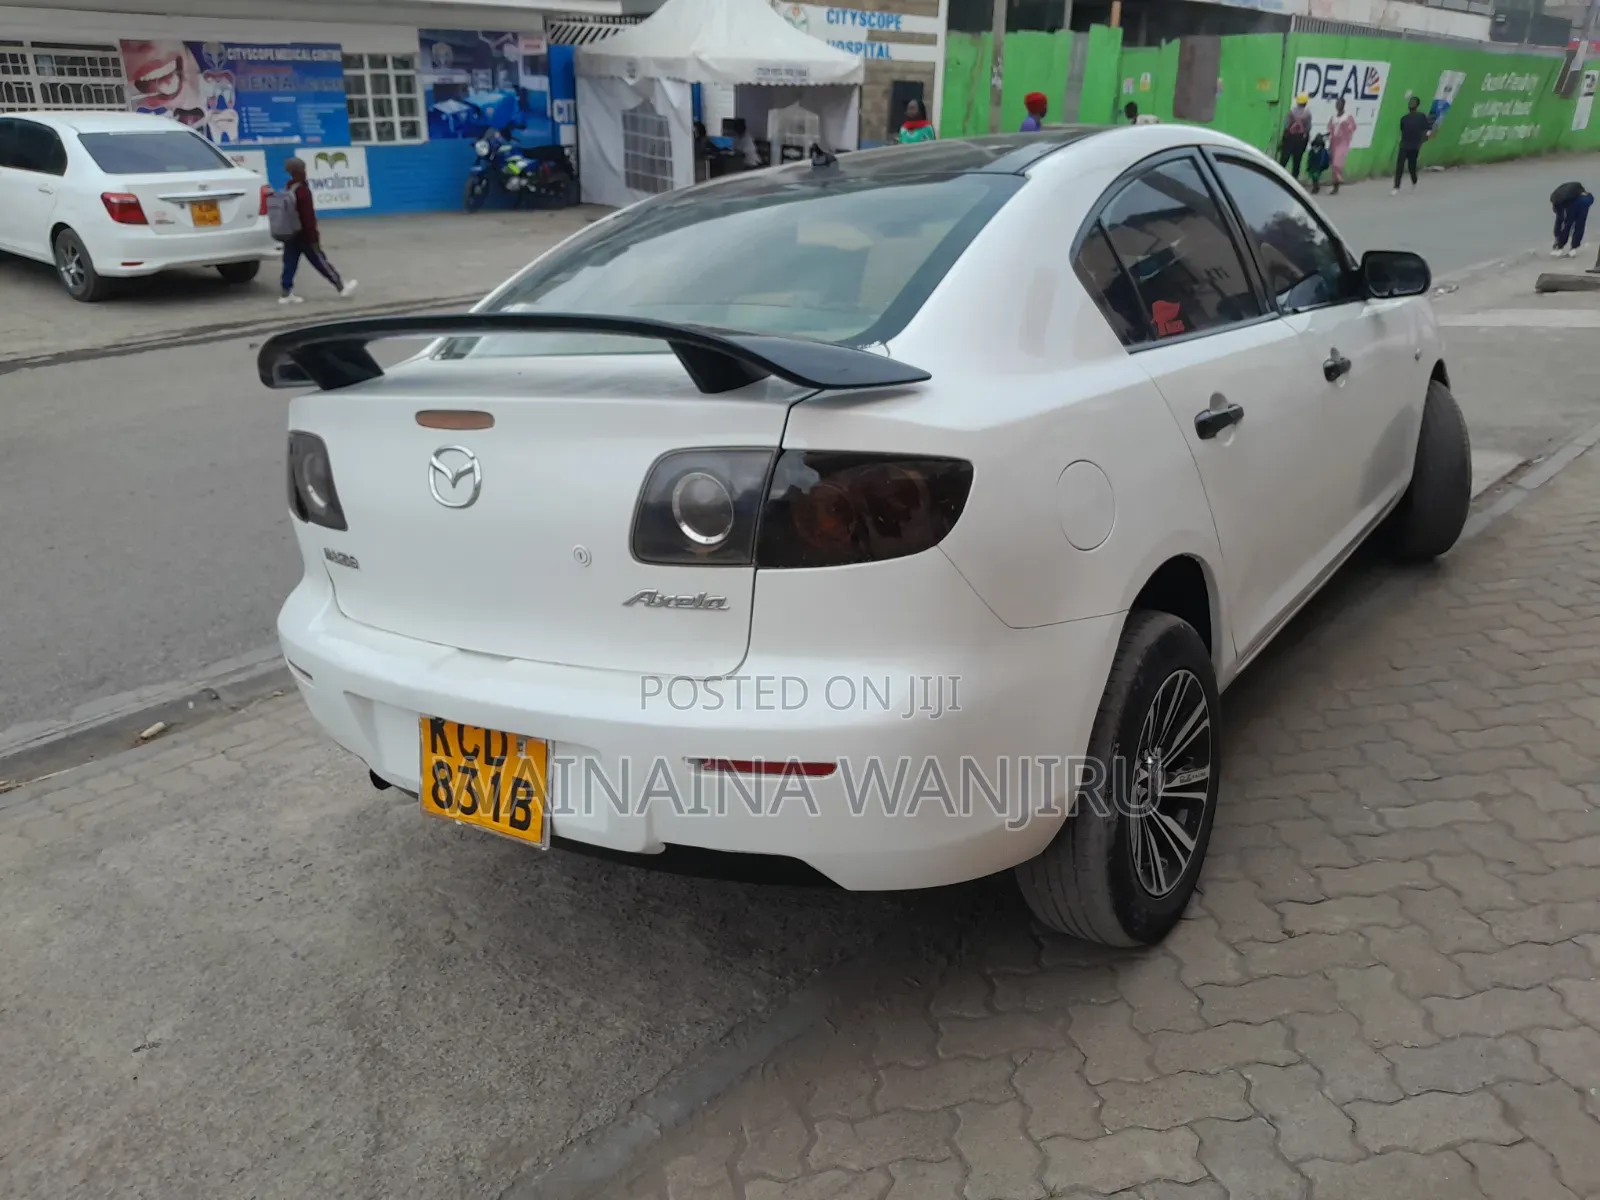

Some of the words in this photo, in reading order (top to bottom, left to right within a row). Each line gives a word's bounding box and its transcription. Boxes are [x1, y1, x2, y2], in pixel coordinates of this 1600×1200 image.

[826, 8, 902, 31] CITYSCOPE
[1294, 63, 1380, 100] IDEAL
[622, 588, 731, 611] Axela
[430, 716, 508, 767] KCD
[431, 760, 534, 831] 831B
